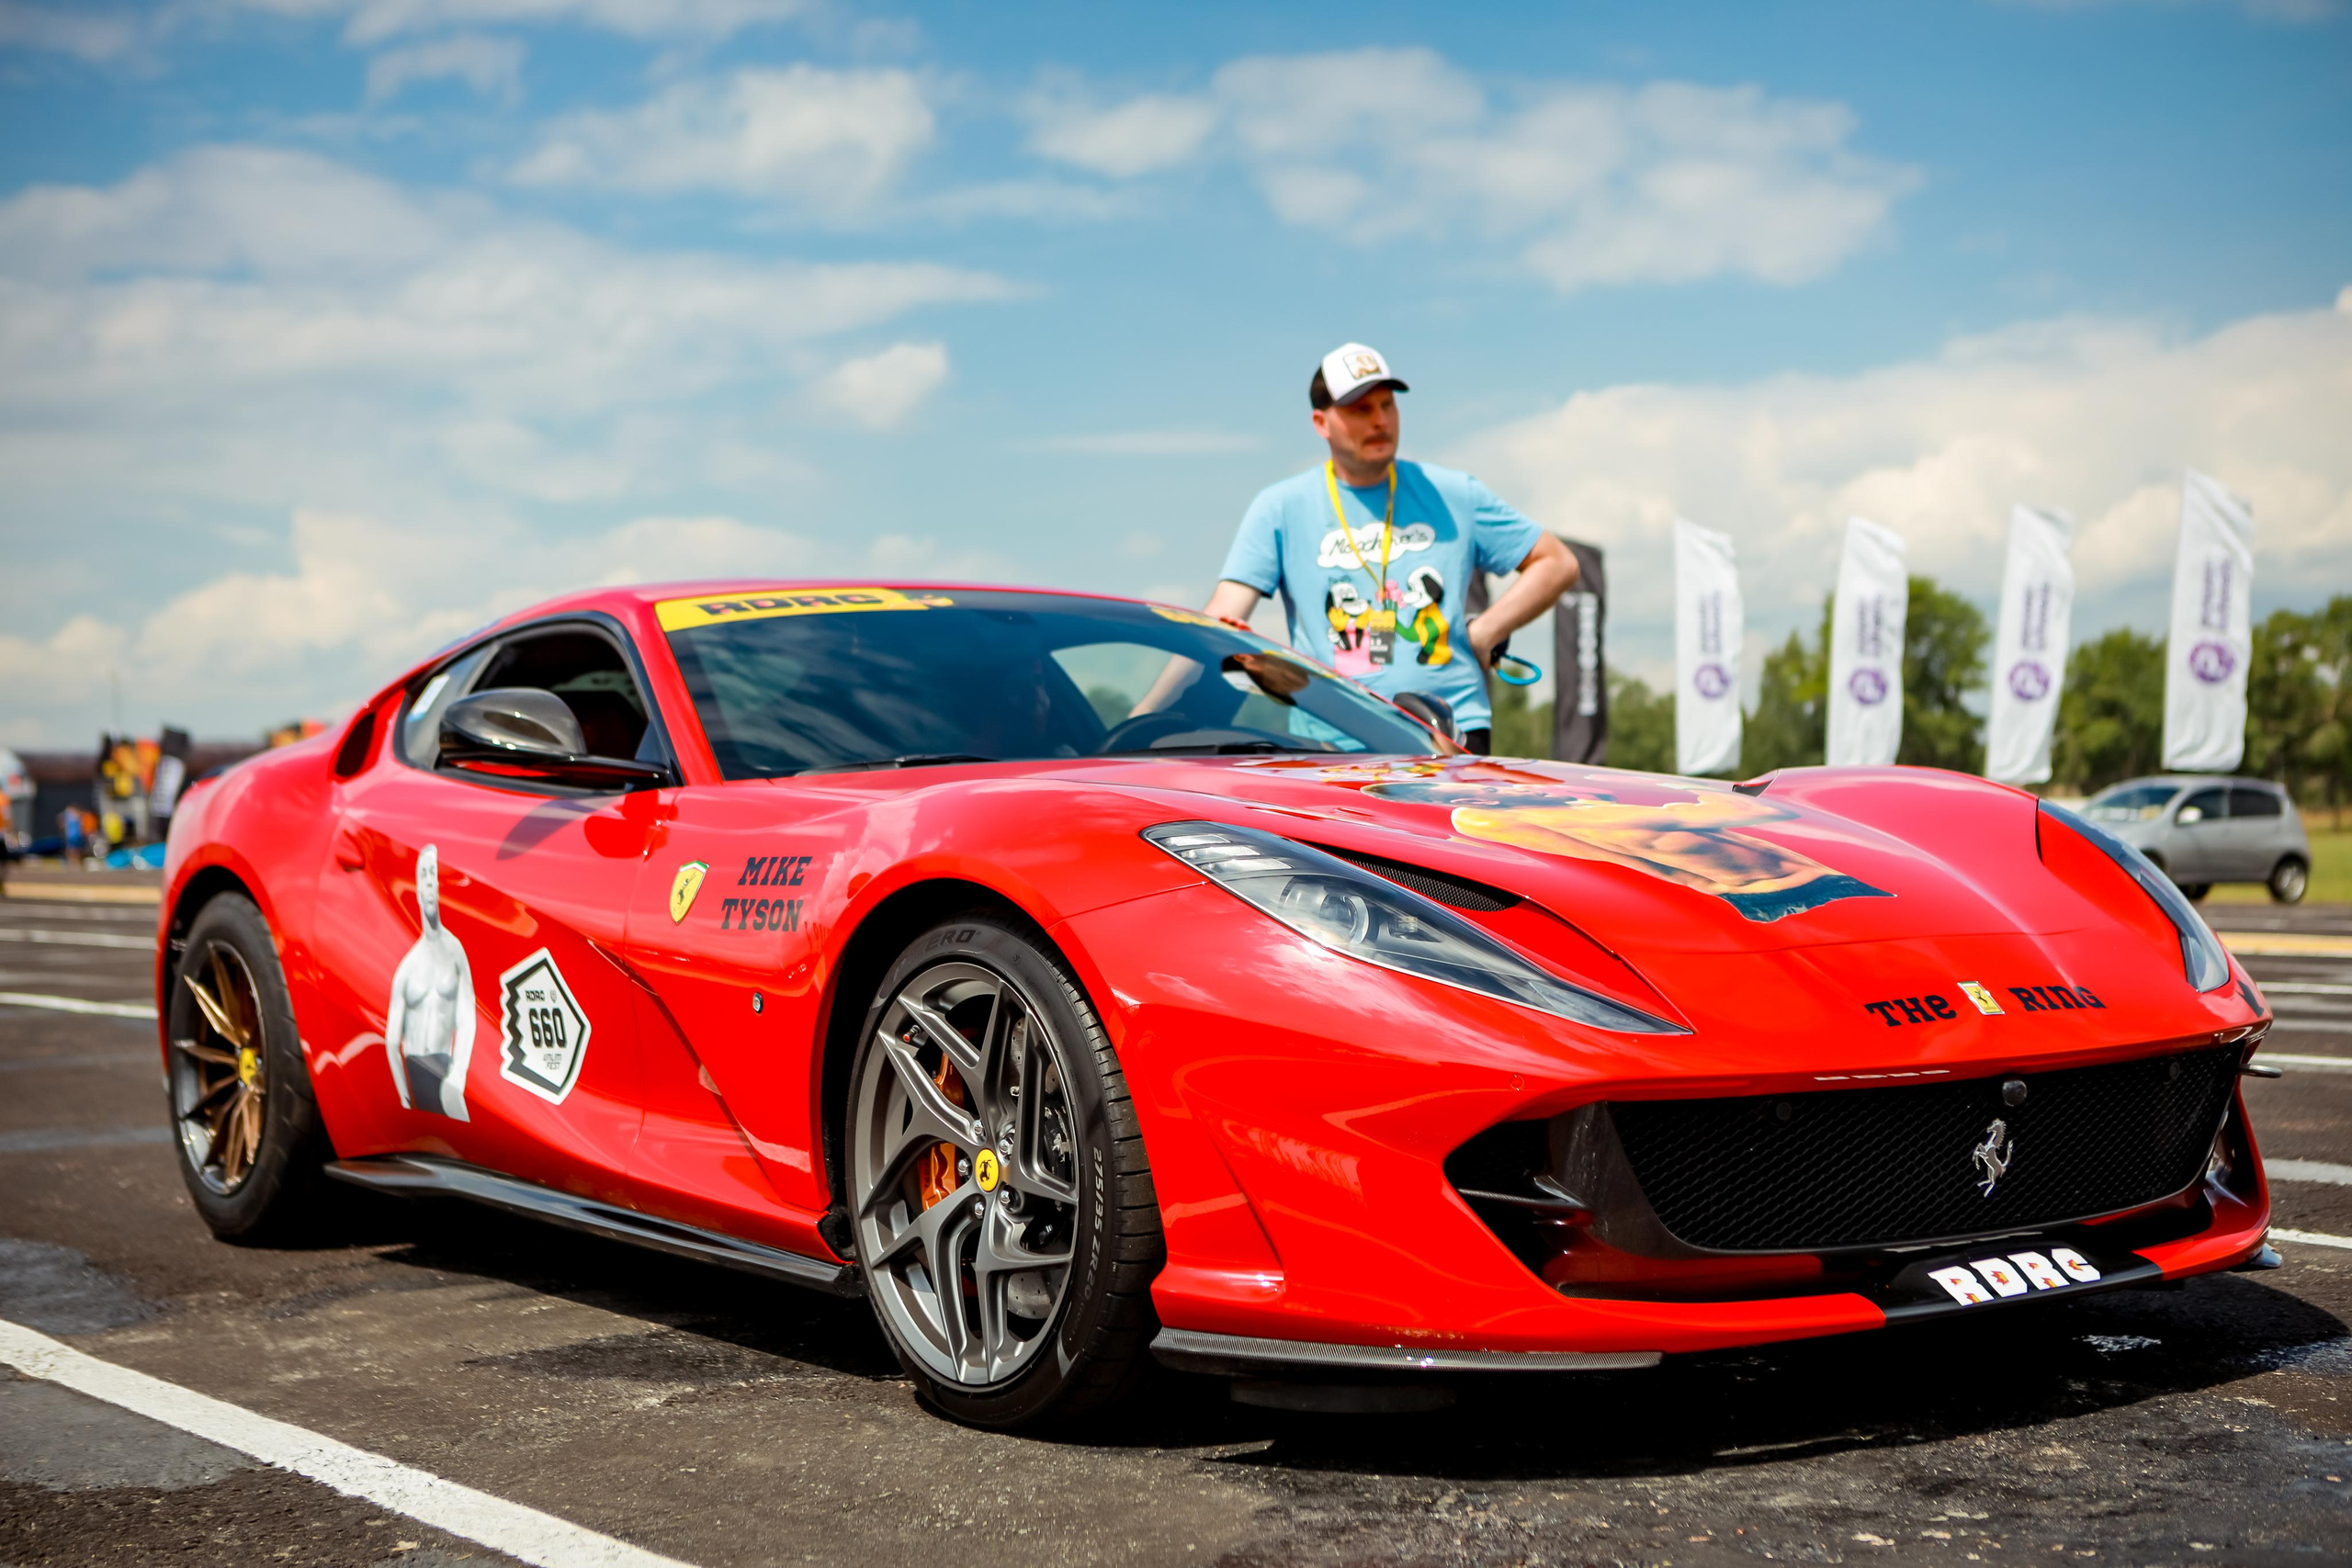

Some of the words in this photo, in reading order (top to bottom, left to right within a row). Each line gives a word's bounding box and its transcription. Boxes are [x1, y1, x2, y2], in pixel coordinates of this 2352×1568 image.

[738, 856, 813, 886] MIKE
[721, 898, 804, 931] TYSON
[529, 1007, 568, 1048] 660
[1093, 1146, 1104, 1233] 275/35
[1084, 1235, 1102, 1301] ZR20
